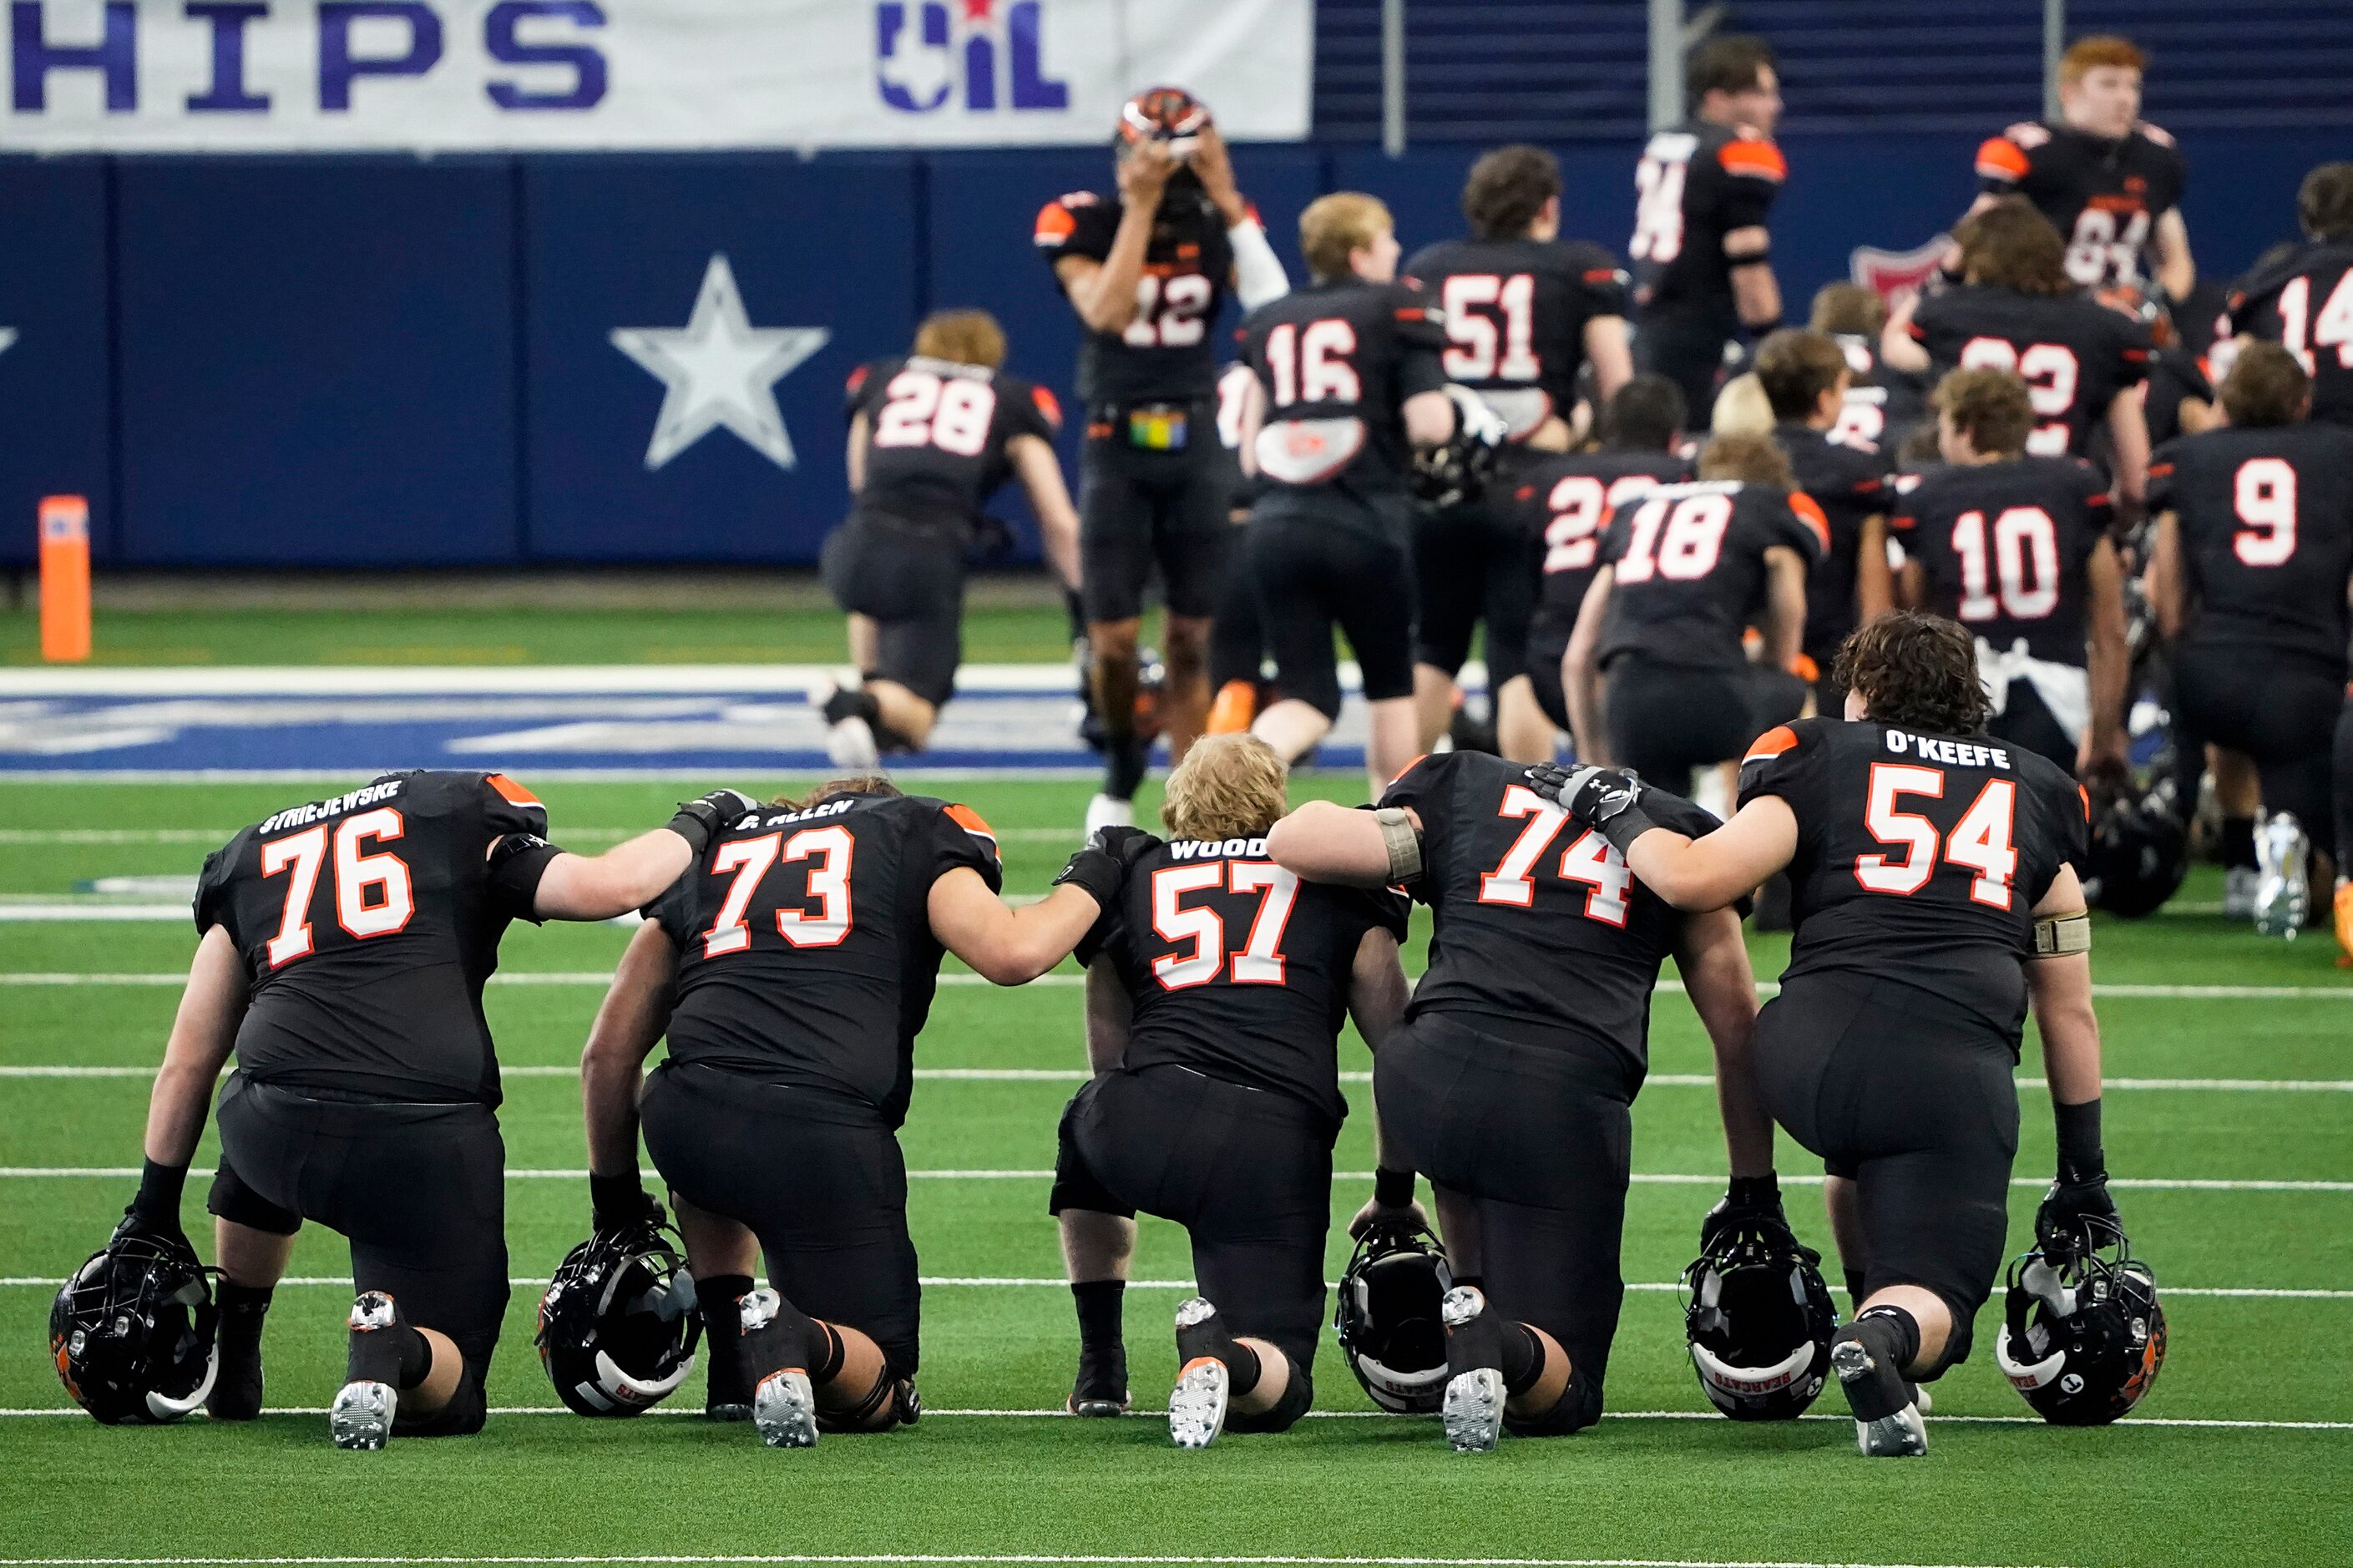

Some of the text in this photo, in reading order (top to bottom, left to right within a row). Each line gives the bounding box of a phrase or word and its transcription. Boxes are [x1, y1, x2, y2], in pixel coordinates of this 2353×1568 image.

[11, 1, 610, 113] HIPS
[1266, 317, 1361, 407] 16
[1443, 274, 1541, 382] 51
[873, 370, 997, 457] 28
[1615, 493, 1736, 585] 18
[1951, 505, 2060, 621] 10
[2233, 457, 2298, 568] 9
[1885, 729, 2011, 770] O'KEEFE
[261, 807, 416, 971] 76
[702, 824, 855, 959] 73
[1477, 783, 1634, 929] 74
[1853, 761, 2018, 912] 54
[1151, 859, 1303, 992] 57
[1714, 1370, 1792, 1393] BEARCATS
